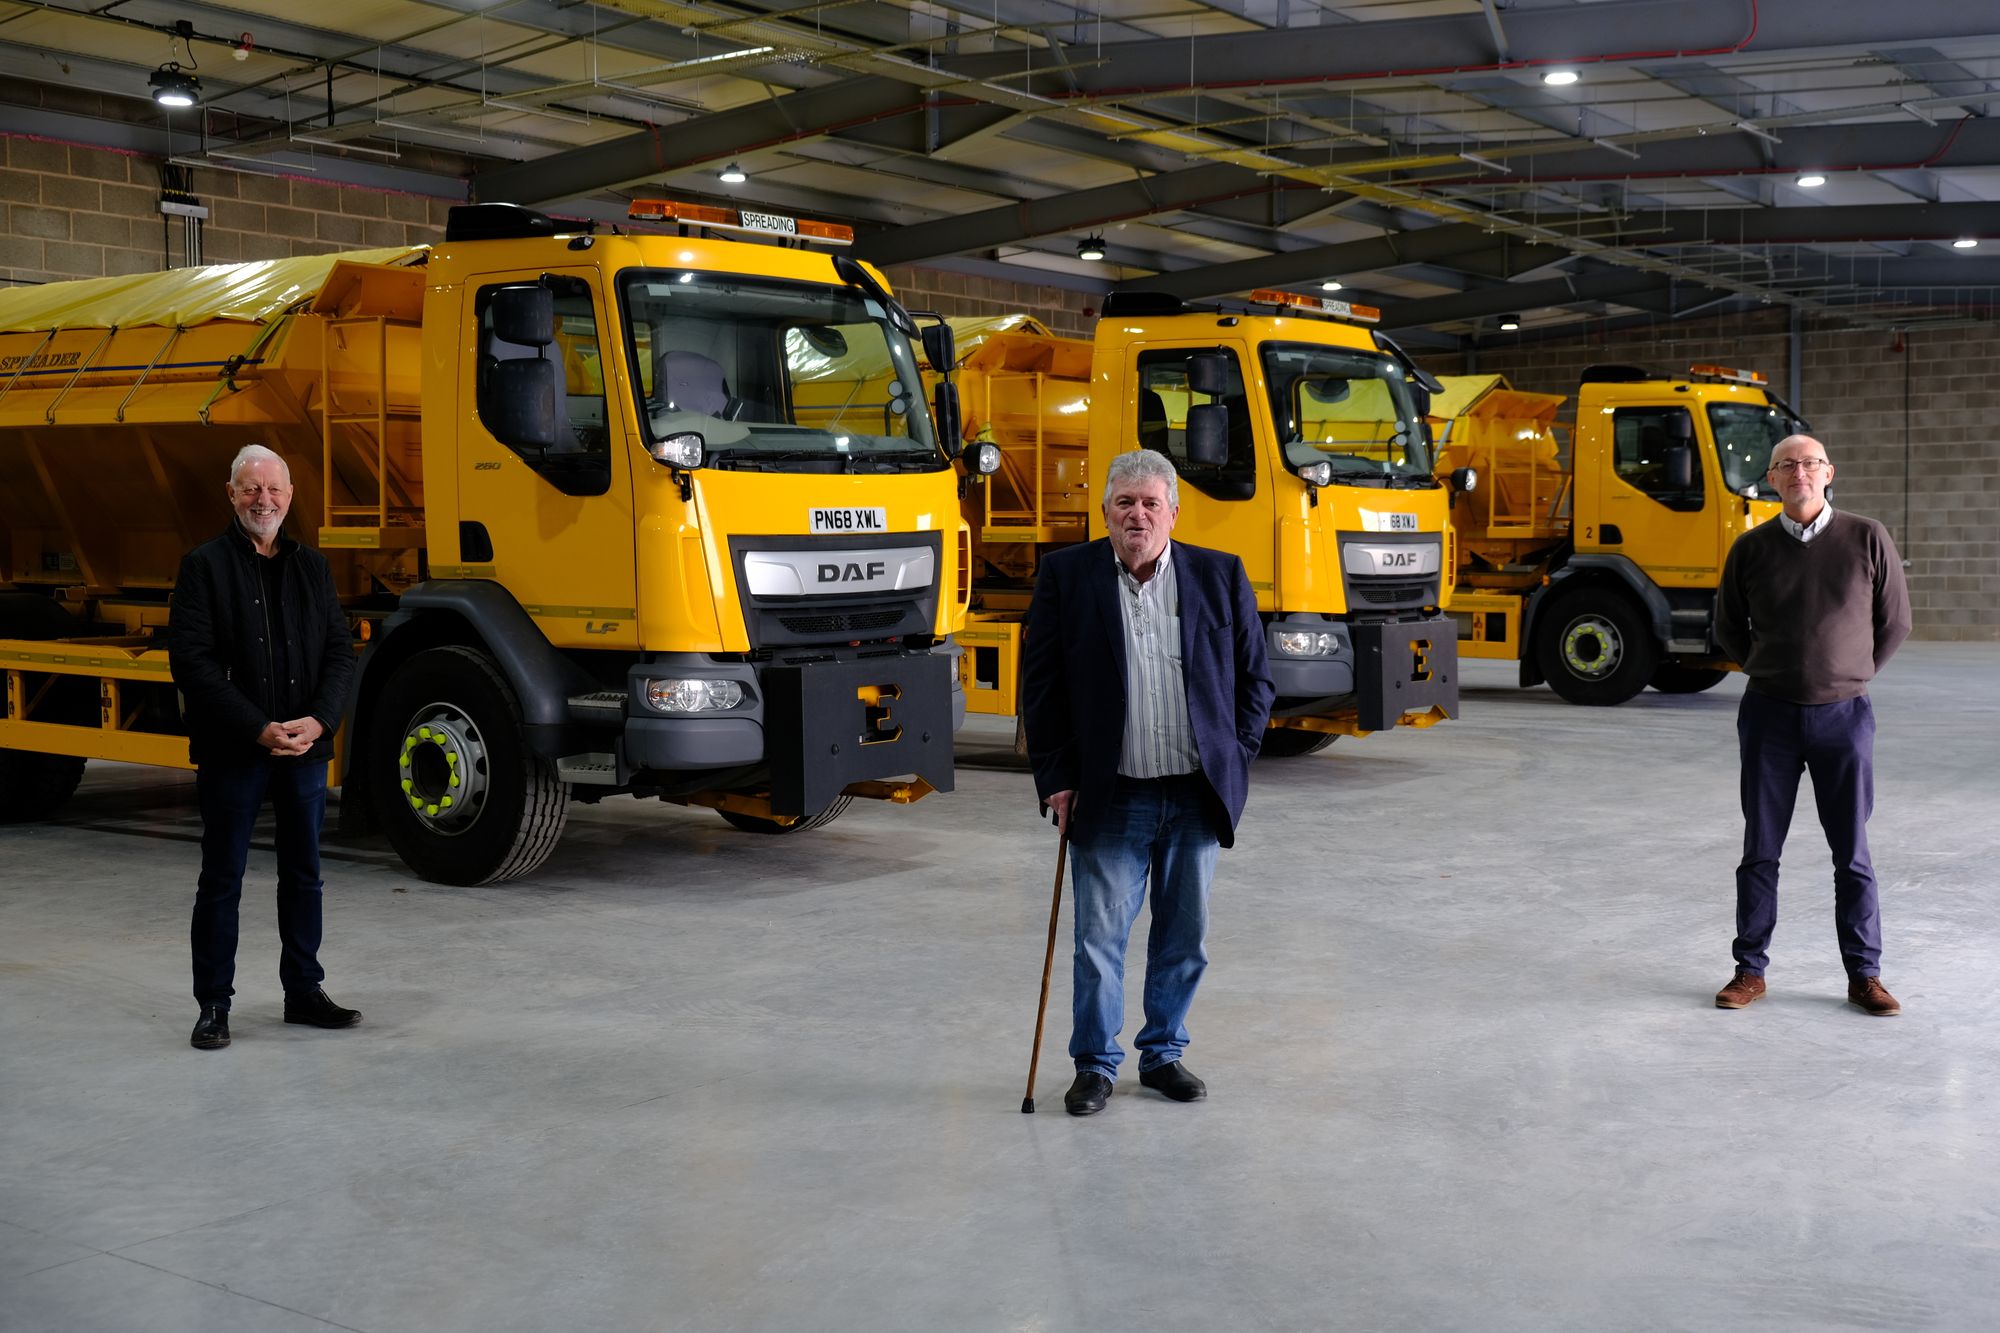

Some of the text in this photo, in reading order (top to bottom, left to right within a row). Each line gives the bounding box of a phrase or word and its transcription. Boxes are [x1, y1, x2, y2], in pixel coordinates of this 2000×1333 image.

[743, 212, 794, 232] SPREADING
[815, 510, 881, 529] PN68 XWL
[1402, 515, 1415, 528] XWJ
[1586, 527, 1592, 538] 2
[1382, 553, 1416, 567] DAF
[818, 562, 884, 582] DAF
[586, 622, 619, 634] LF
